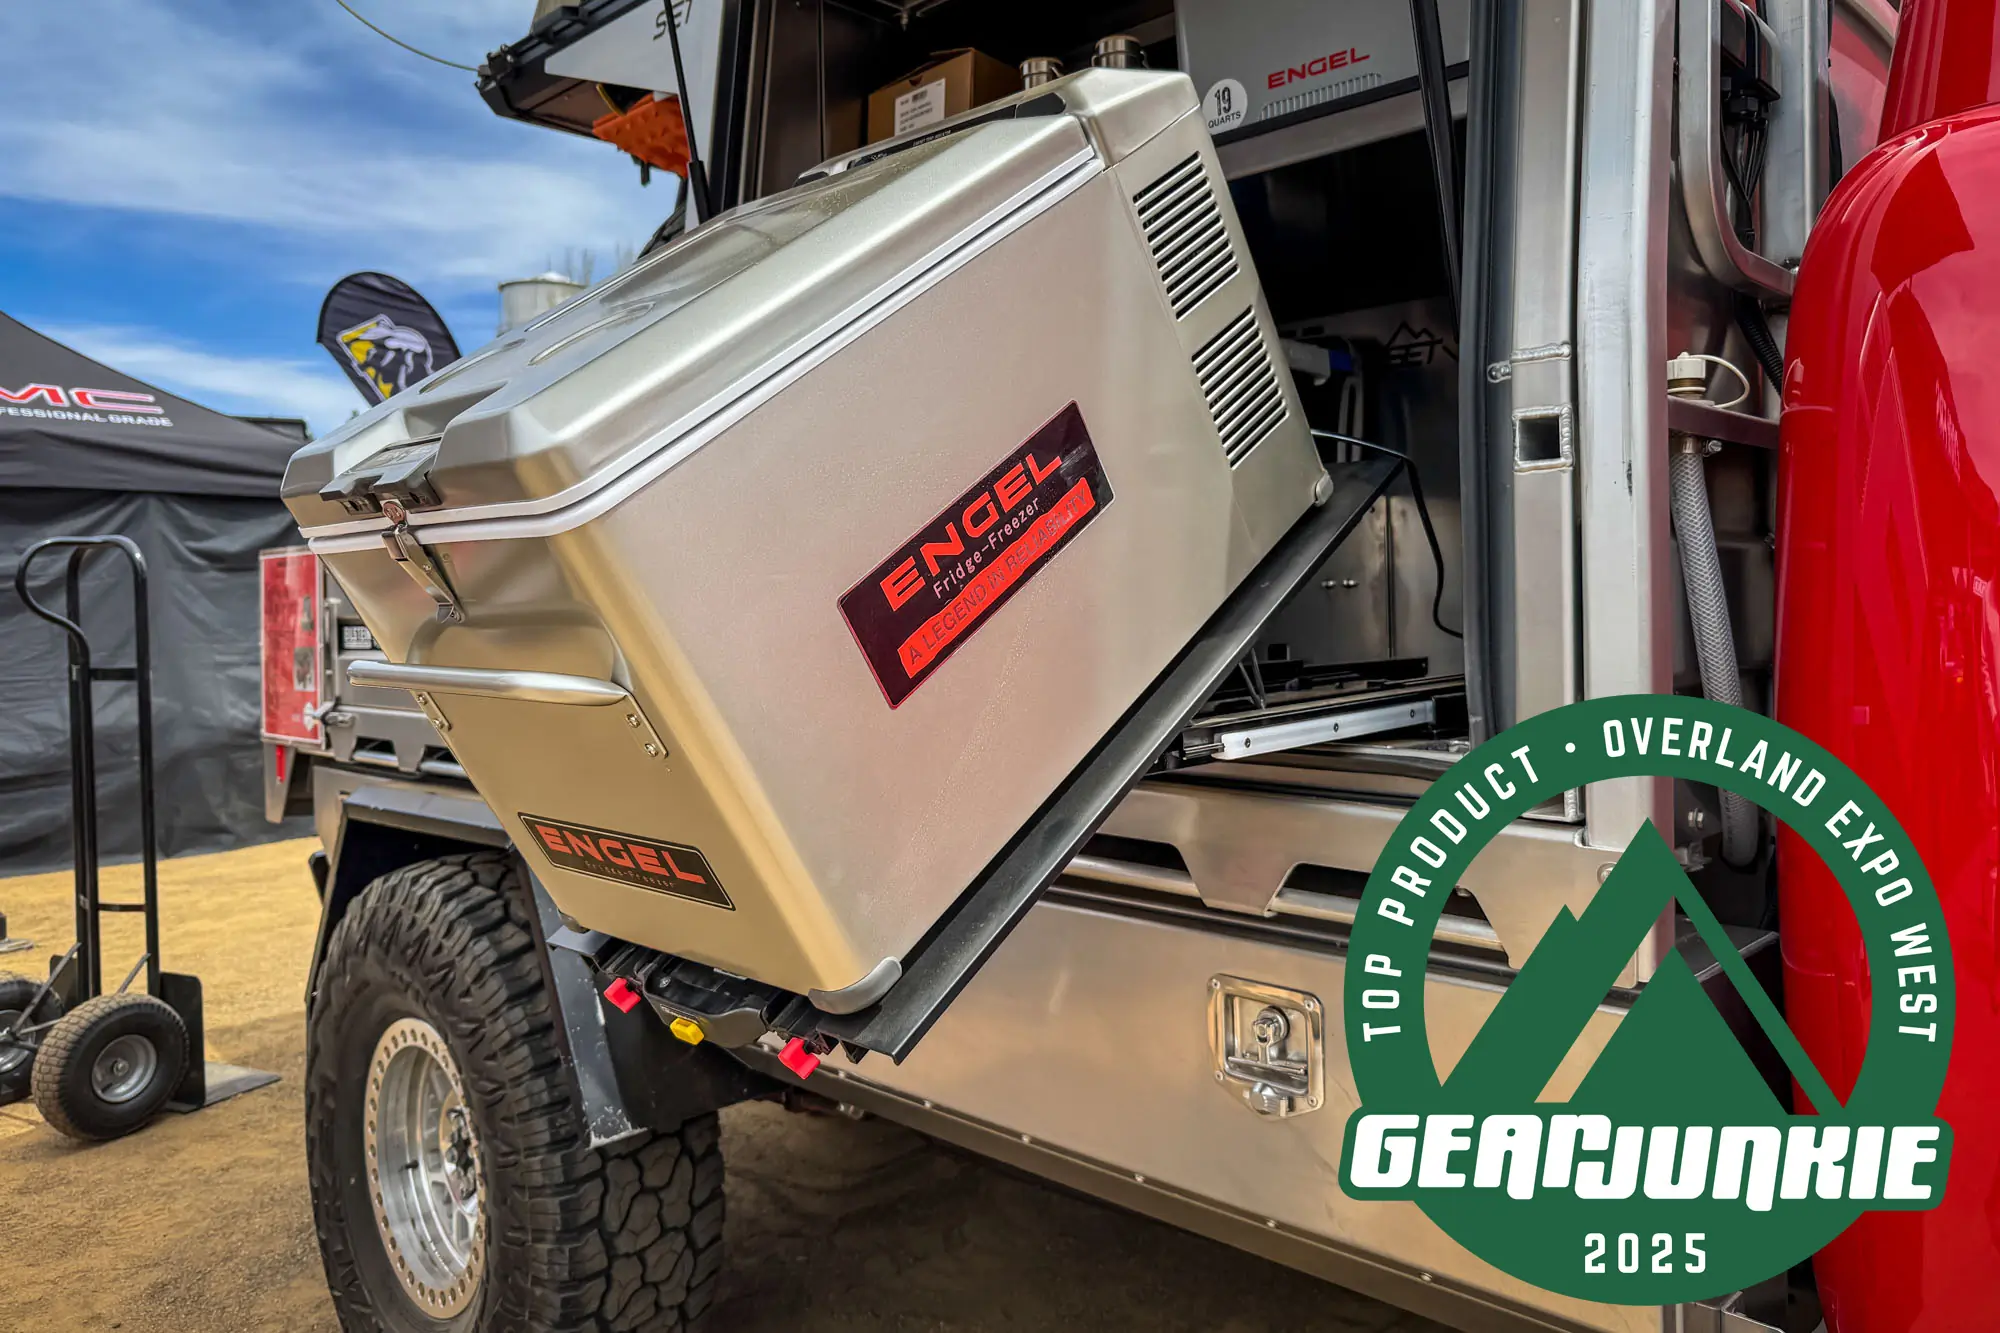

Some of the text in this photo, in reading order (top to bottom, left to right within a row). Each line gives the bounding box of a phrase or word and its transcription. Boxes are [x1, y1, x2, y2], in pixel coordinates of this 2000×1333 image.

[1267, 47, 1370, 90] ENGEL
[1208, 111, 1241, 128] QUARTS
[1214, 86, 1231, 117] 19
[108, 414, 173, 427] GRADE
[880, 453, 1063, 612] ENGEL
[933, 497, 1040, 599] Fridge-Freezer
[909, 488, 1088, 665] A LEGEND IN RELIABILITY
[535, 824, 707, 885] ENGEL
